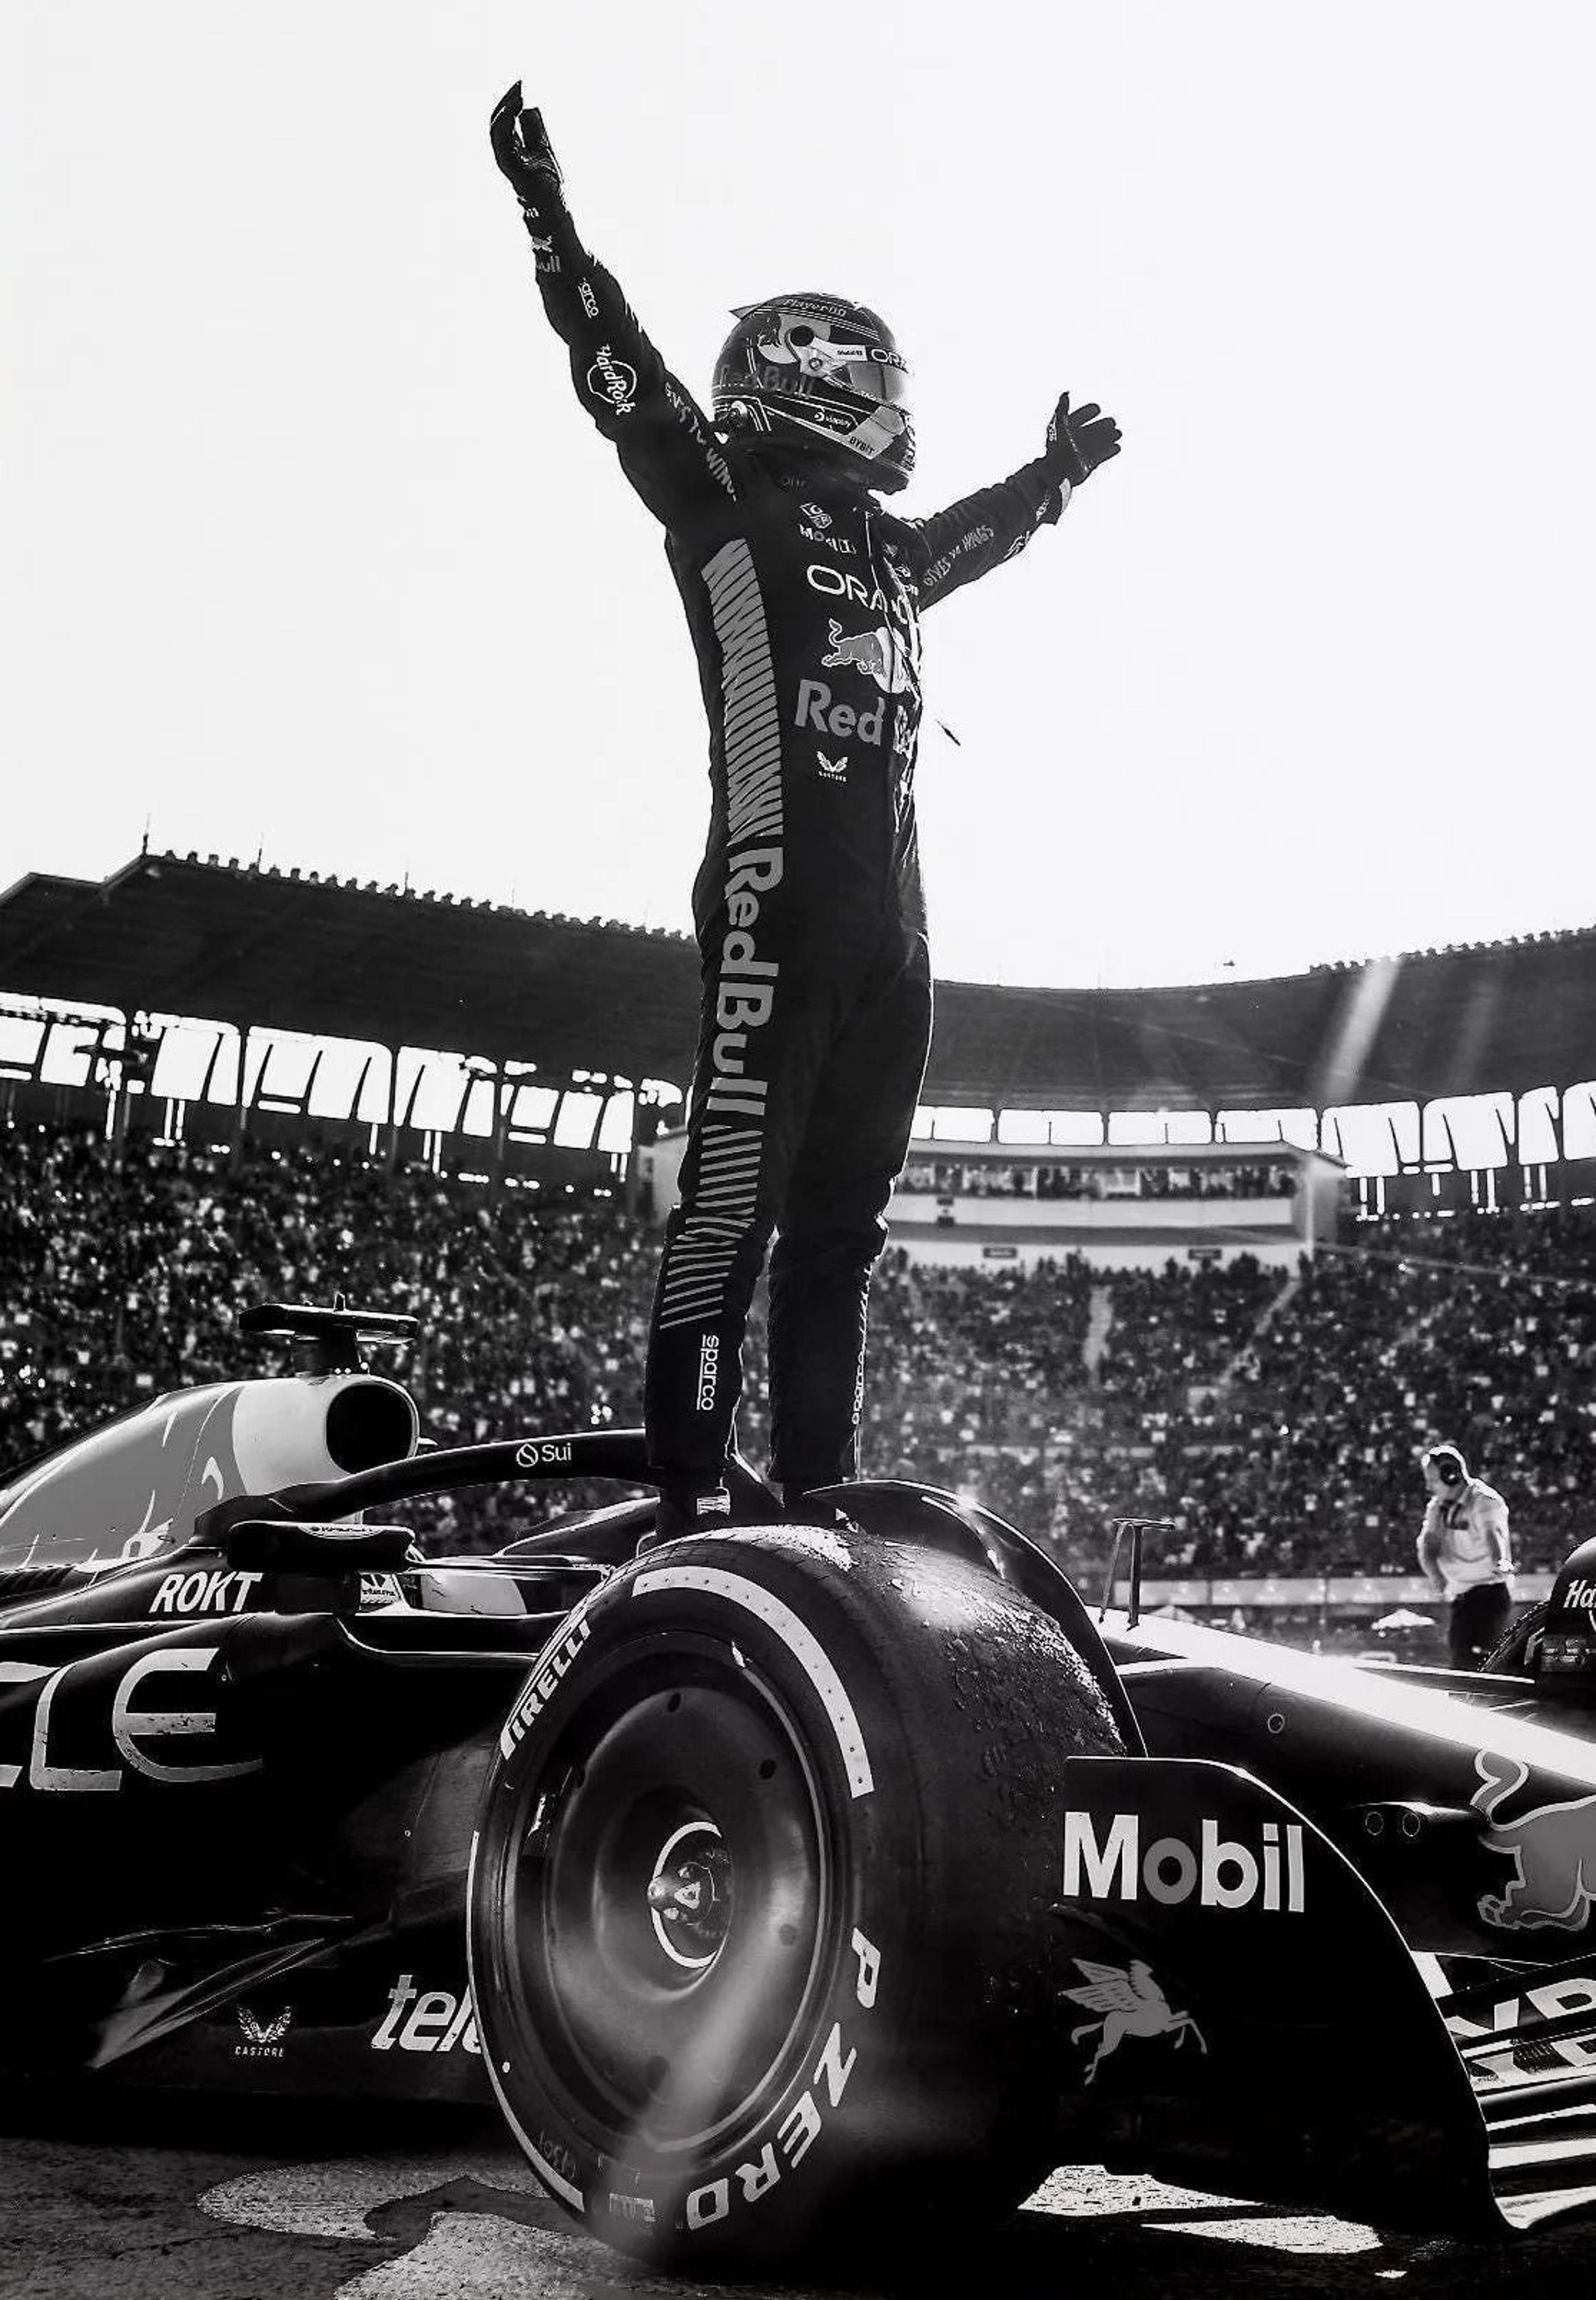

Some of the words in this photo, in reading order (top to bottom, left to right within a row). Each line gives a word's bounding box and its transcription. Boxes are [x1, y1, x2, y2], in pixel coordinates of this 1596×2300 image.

[794, 679, 885, 746] Red
[696, 1335, 719, 1411] sparco
[542, 1442, 572, 1463] Sui
[149, 1572, 264, 1613] ROKT
[1563, 1580, 1596, 1608] Ha
[1063, 1811, 1304, 1913] Mobil
